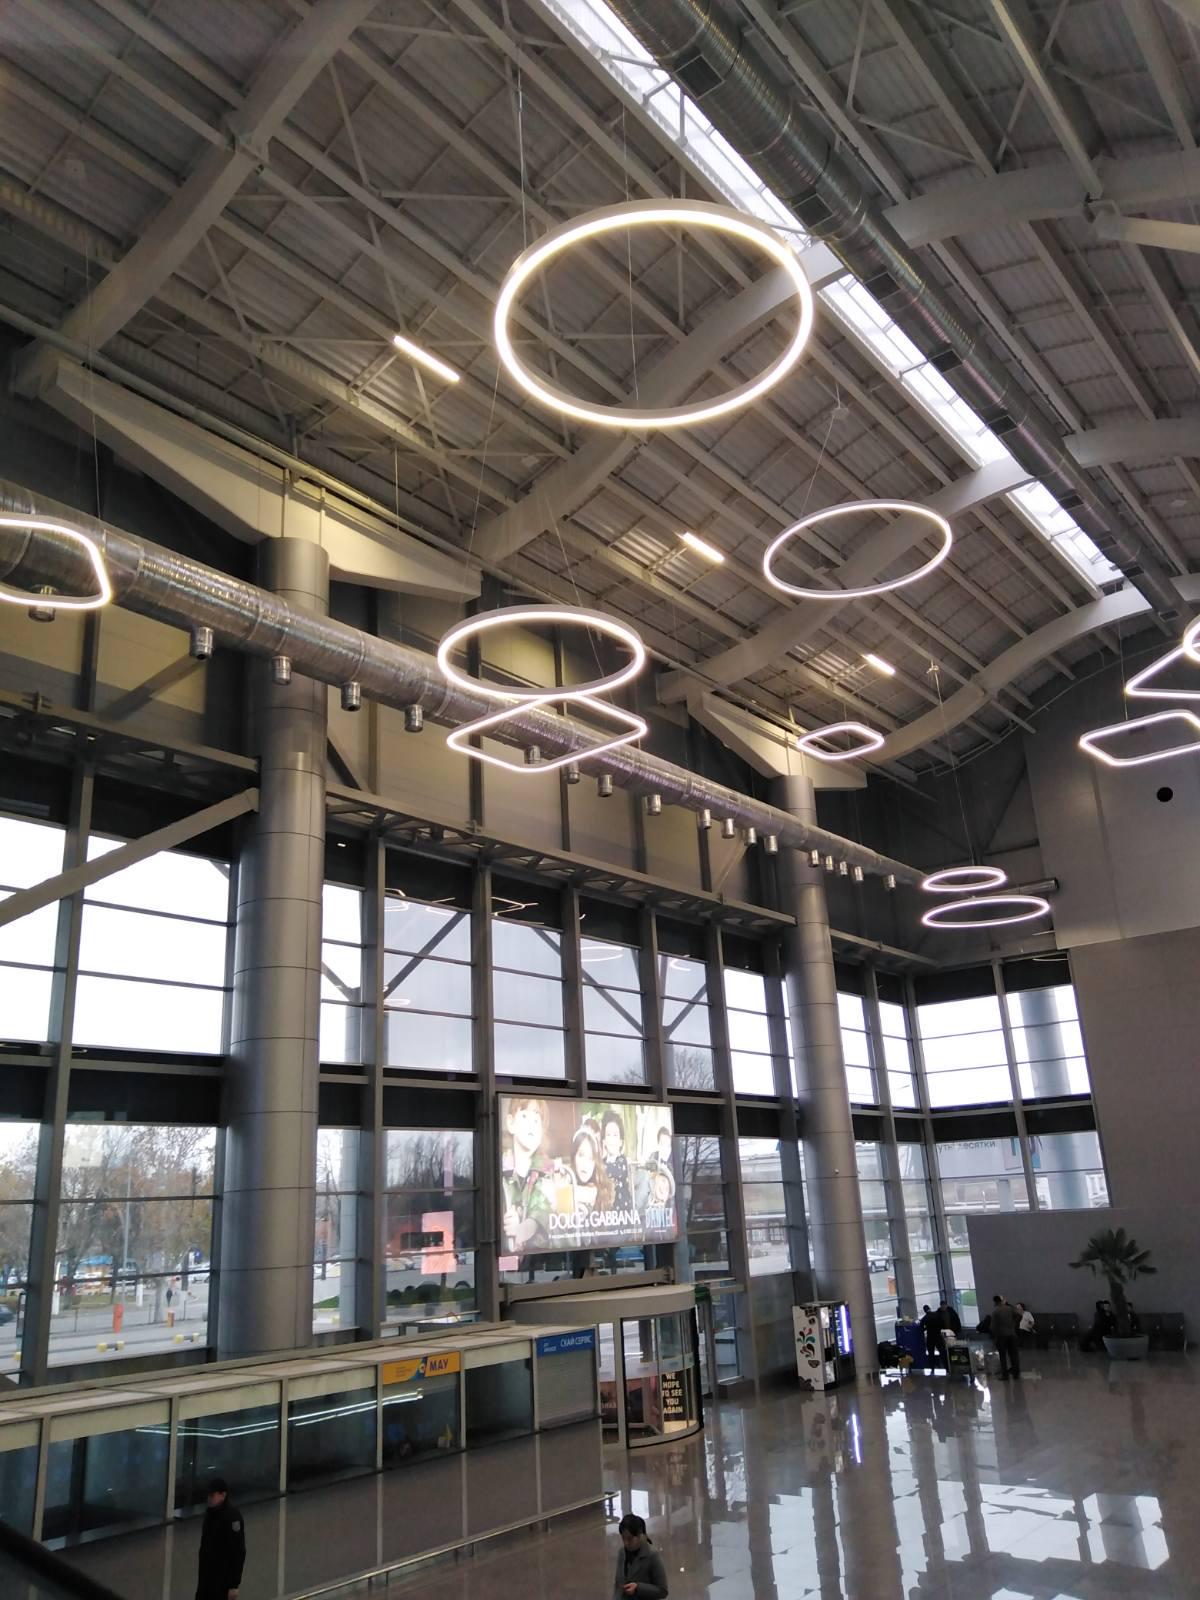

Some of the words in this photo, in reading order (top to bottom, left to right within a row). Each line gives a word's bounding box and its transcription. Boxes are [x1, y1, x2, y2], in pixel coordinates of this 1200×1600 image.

[590, 1210, 641, 1227] GABBANA
[429, 1359, 448, 1372] MAY
[663, 1381, 680, 1389] HOPE
[662, 1389, 670, 1397] TO
